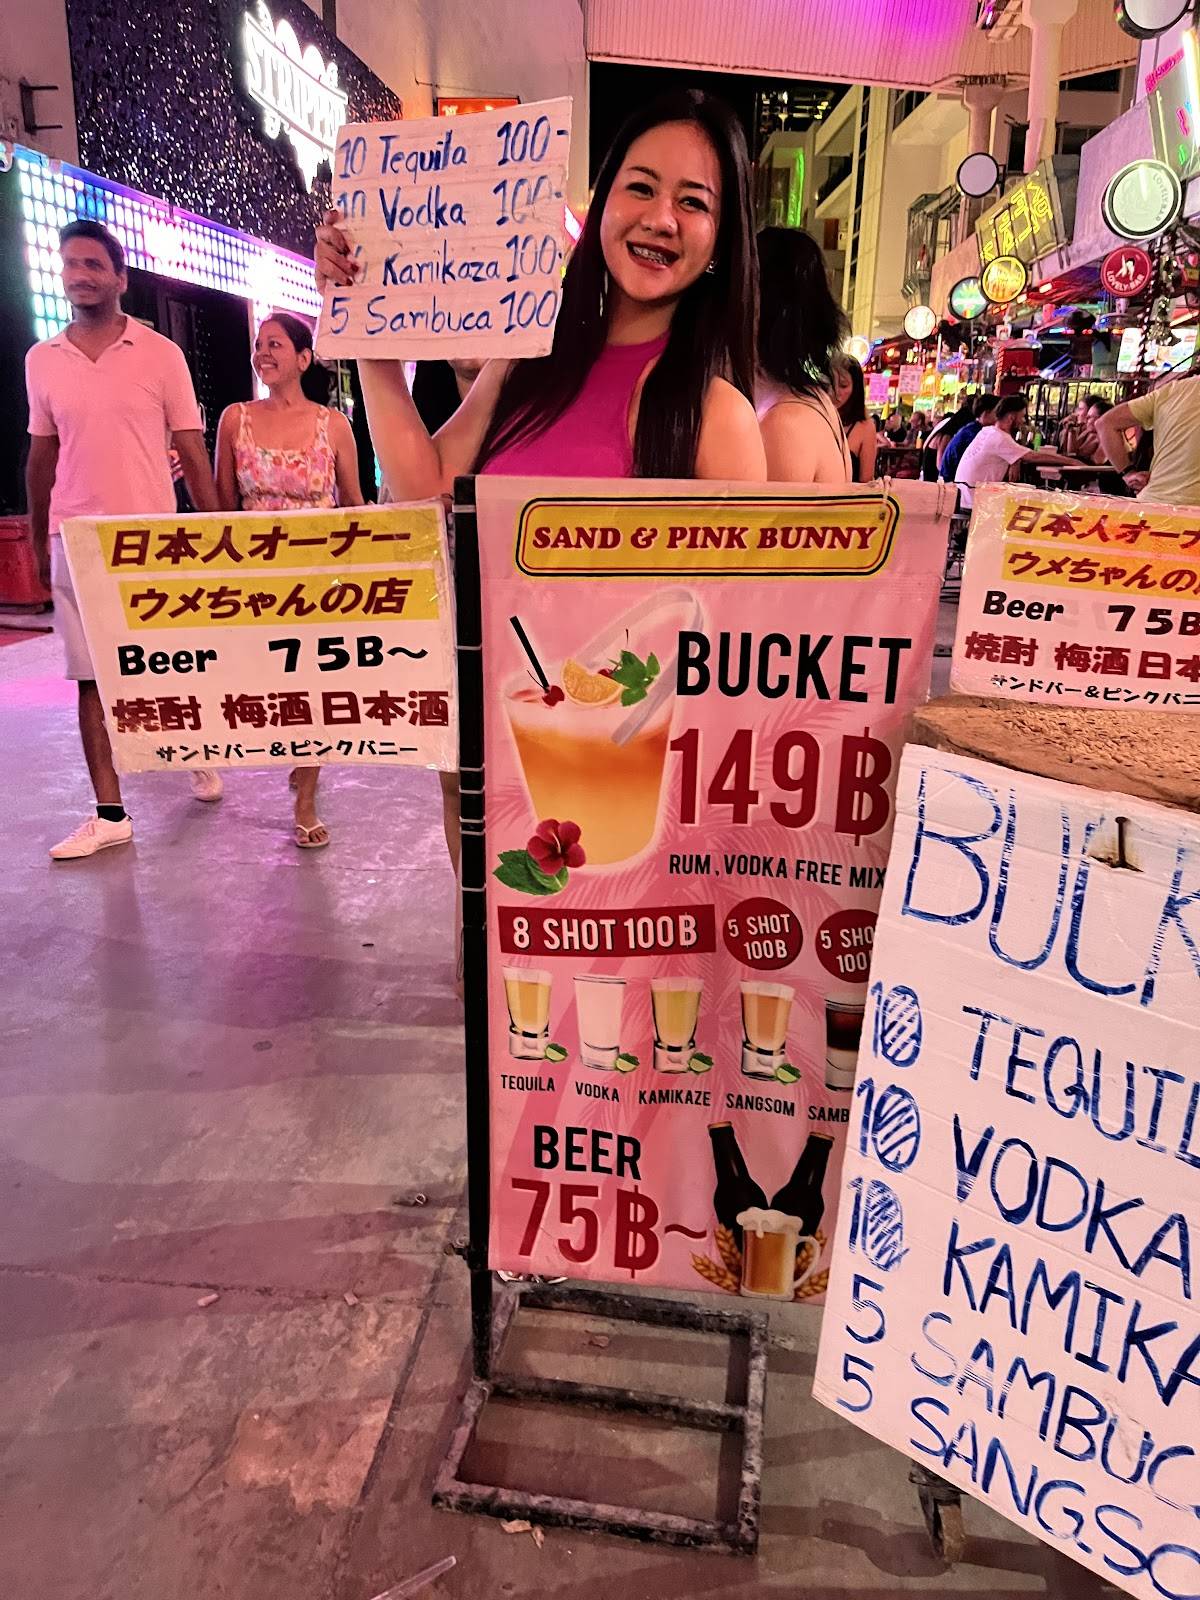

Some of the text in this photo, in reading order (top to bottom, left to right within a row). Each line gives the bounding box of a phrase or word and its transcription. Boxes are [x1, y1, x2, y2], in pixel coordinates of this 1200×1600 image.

[338, 136, 368, 179] 10
[379, 185, 467, 231] Vodka
[1106, 270, 1145, 291] LOVELY BAR
[330, 290, 558, 336] 5 Sambuca 100
[111, 521, 411, 567] 日本人オーナー
[532, 526, 878, 550] SAND & PINK BUNNY
[1007, 550, 1200, 596] ウメちゃんの
[129, 577, 413, 622] ウメちゃんの店
[982, 590, 1064, 622] Beer
[117, 644, 218, 676] Beer
[675, 630, 912, 705] BUCKET
[964, 630, 1039, 667] 焼酎
[111, 695, 202, 733] 焼酎
[724, 855, 788, 879] VODKA
[795, 859, 842, 886] FREE
[512, 915, 530, 950] 8
[543, 915, 616, 950] SHOT
[727, 914, 792, 937] 5 SHOT
[821, 930, 832, 949] 5
[836, 950, 873, 973] 100
[871, 981, 923, 1068] 10
[500, 1074, 850, 1123] TEQUILA VODKA KAMIKAZE SANGSOM SAMB
[533, 1125, 642, 1181] BEER
[856, 1077, 1193, 1300] 10 VODKA
[847, 1177, 910, 1272] 10
[845, 1273, 886, 1344] 5
[836, 1352, 875, 1412] 5
